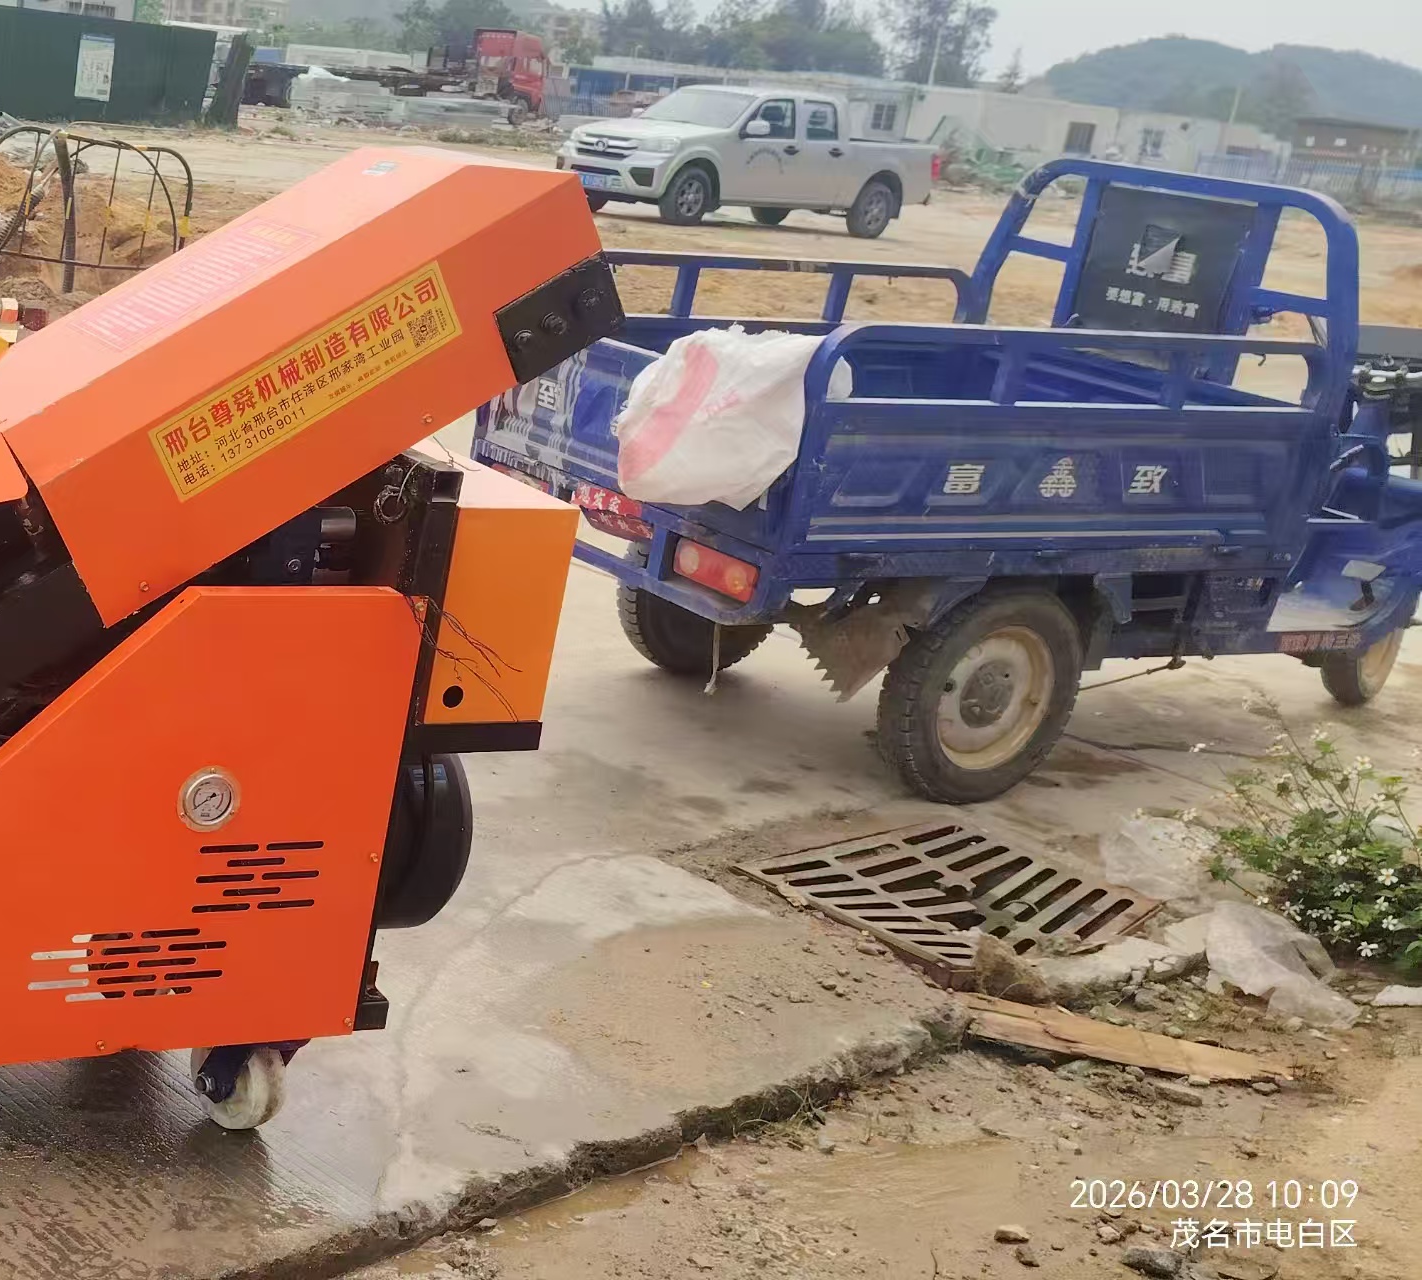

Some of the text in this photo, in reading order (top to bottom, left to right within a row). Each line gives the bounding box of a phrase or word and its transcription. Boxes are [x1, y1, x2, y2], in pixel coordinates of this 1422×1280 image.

[162, 276, 439, 459] 邢台尊舜机械制造有限公司
